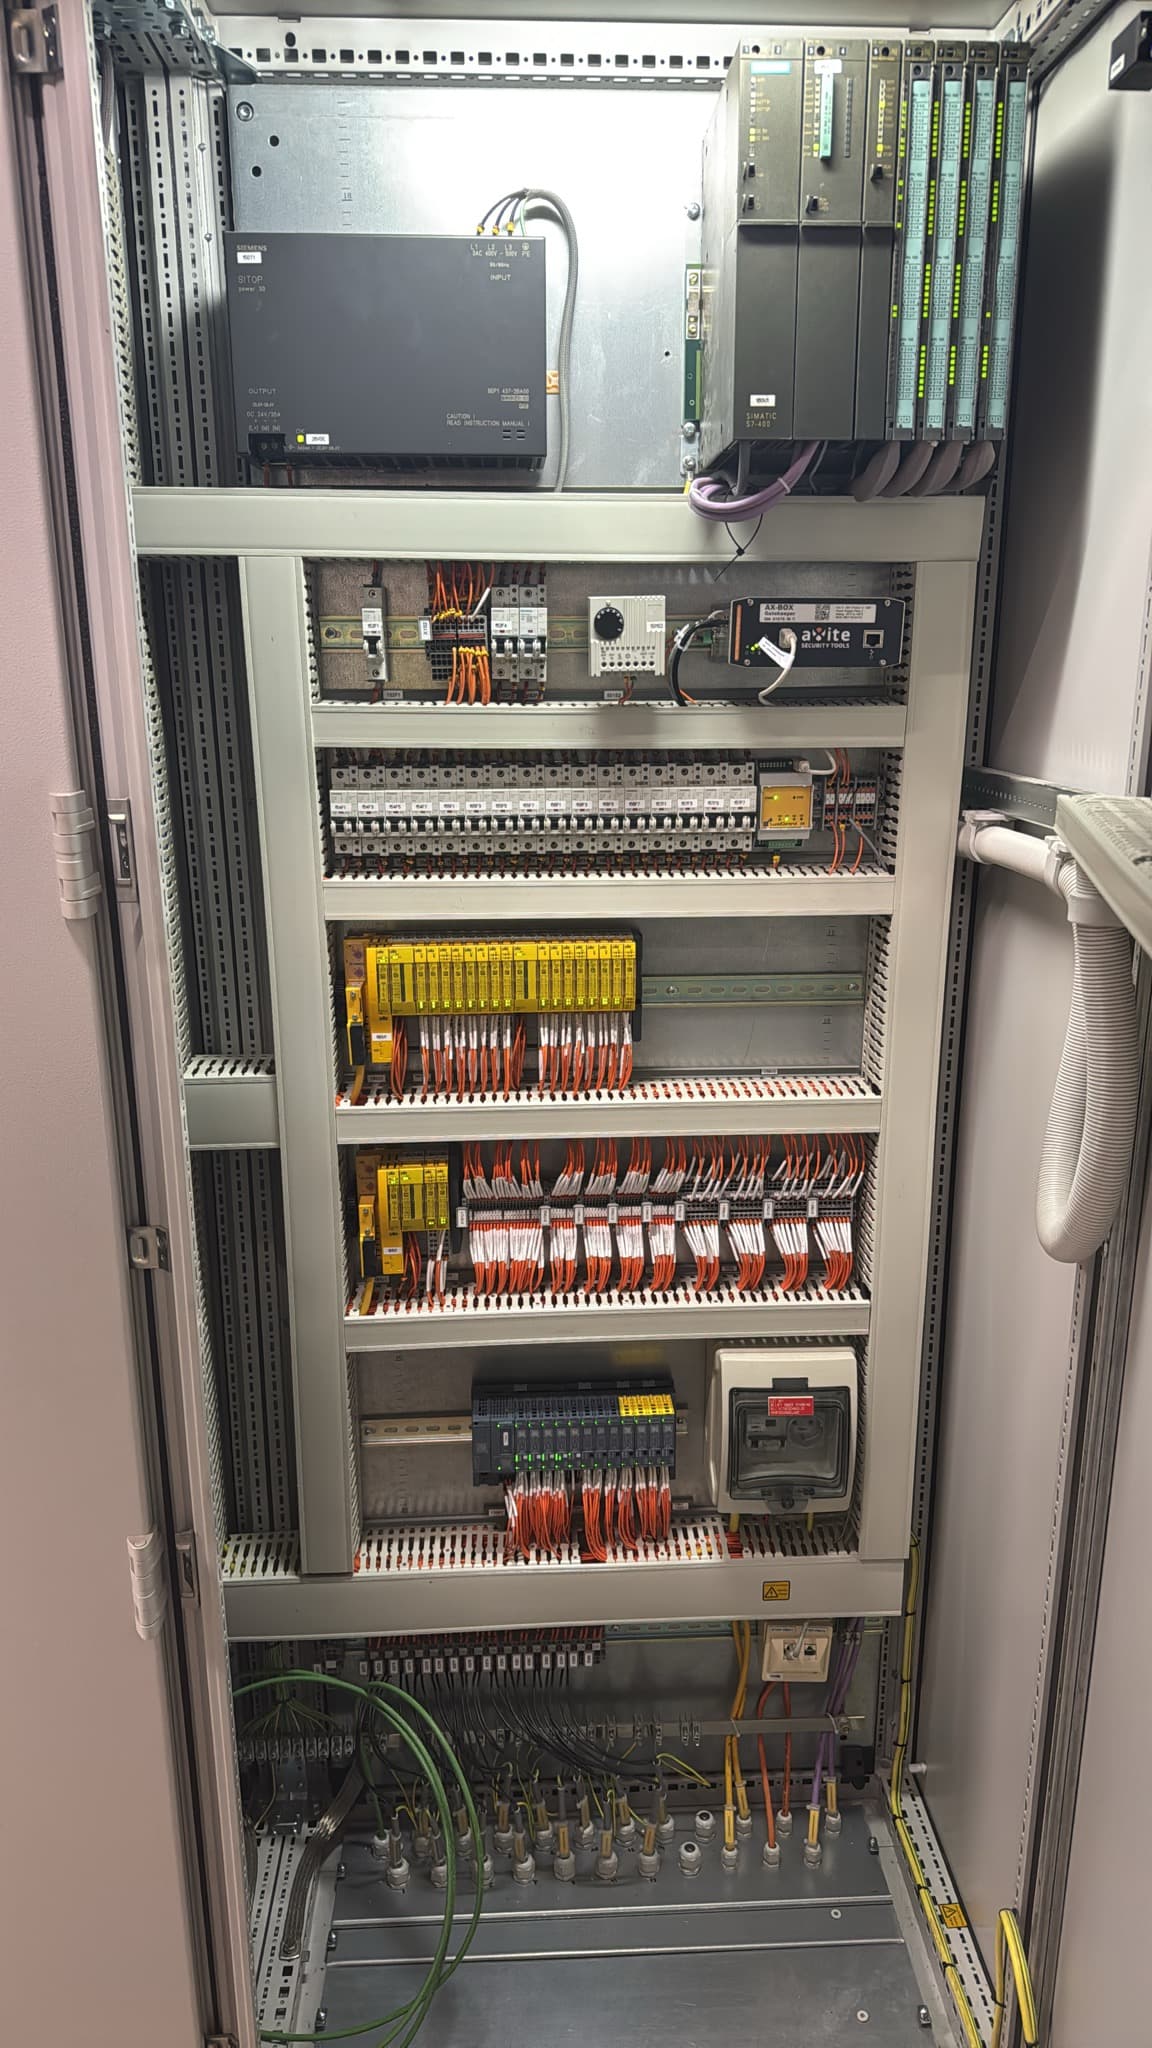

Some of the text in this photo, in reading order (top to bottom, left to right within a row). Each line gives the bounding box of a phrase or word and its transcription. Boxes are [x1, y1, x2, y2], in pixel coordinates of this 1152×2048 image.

[236, 244, 267, 252] SIEMENS
[239, 275, 263, 284] SITOP
[502, 419, 525, 427] MANUAL
[764, 604, 794, 612] AX-BOX
